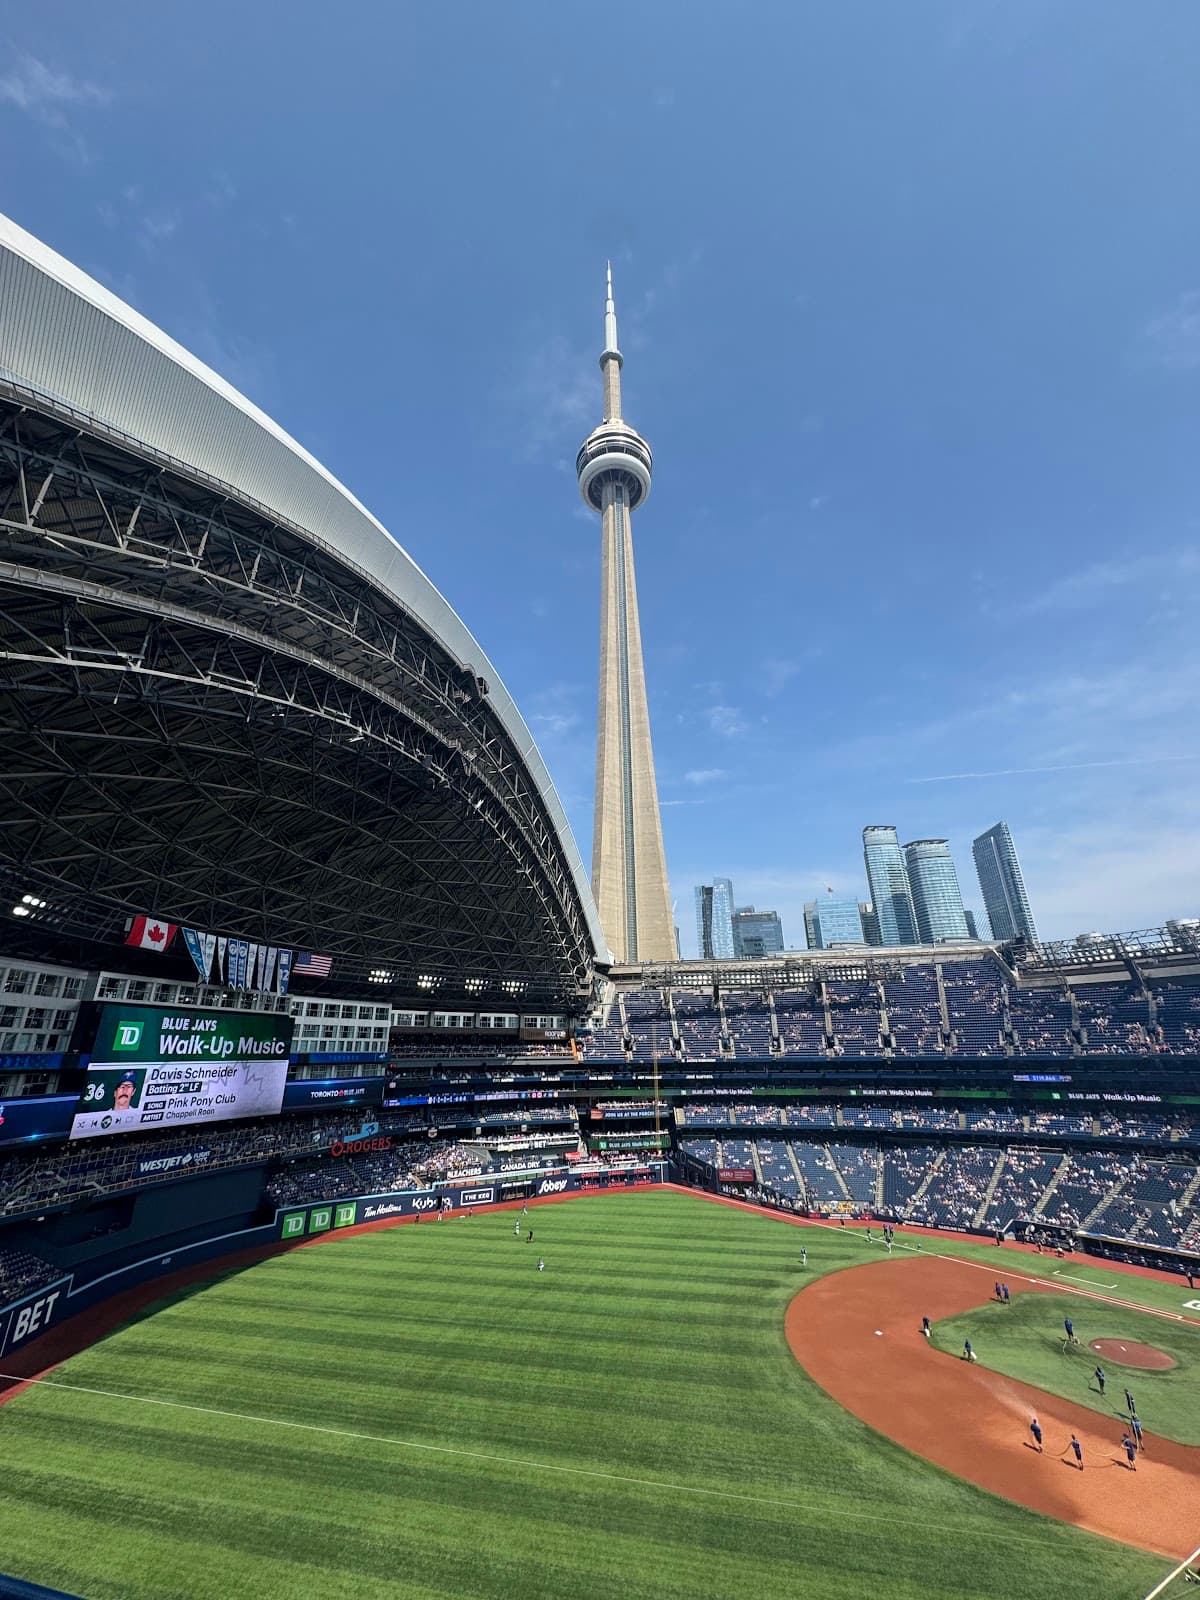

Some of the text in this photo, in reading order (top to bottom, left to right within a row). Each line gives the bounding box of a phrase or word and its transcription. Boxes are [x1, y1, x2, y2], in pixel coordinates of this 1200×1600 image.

[162, 1017, 217, 1032] BLUE JAYS
[119, 1026, 140, 1045] TD
[159, 1035, 285, 1058] Walk-Up Music
[151, 1066, 237, 1080] Davis Schneider
[84, 1083, 105, 1101] 36
[148, 1084, 178, 1095] Batting
[190, 1082, 200, 1092] LF
[311, 1090, 339, 1099] TORONTO
[168, 1097, 189, 1109] Pink
[191, 1096, 213, 1106] Pony
[215, 1093, 236, 1104] Club
[1102, 1093, 1136, 1102] Walk-Up
[1136, 1094, 1161, 1102] Music
[143, 1113, 161, 1121] ARTIST
[166, 1109, 197, 1119] Chappell
[347, 1136, 391, 1153] ROGERS
[534, 1140, 547, 1149] BET
[140, 1156, 183, 1172] WESTJET
[447, 1160, 540, 1179] BLEACHERS CANADA DRY
[538, 1179, 567, 1194] Sobeys
[337, 1206, 353, 1222] TD
[364, 1203, 402, 1218] Tim Hortons
[286, 1216, 303, 1233] TD
[312, 1212, 329, 1227] TD
[12, 1291, 60, 1343] BET
